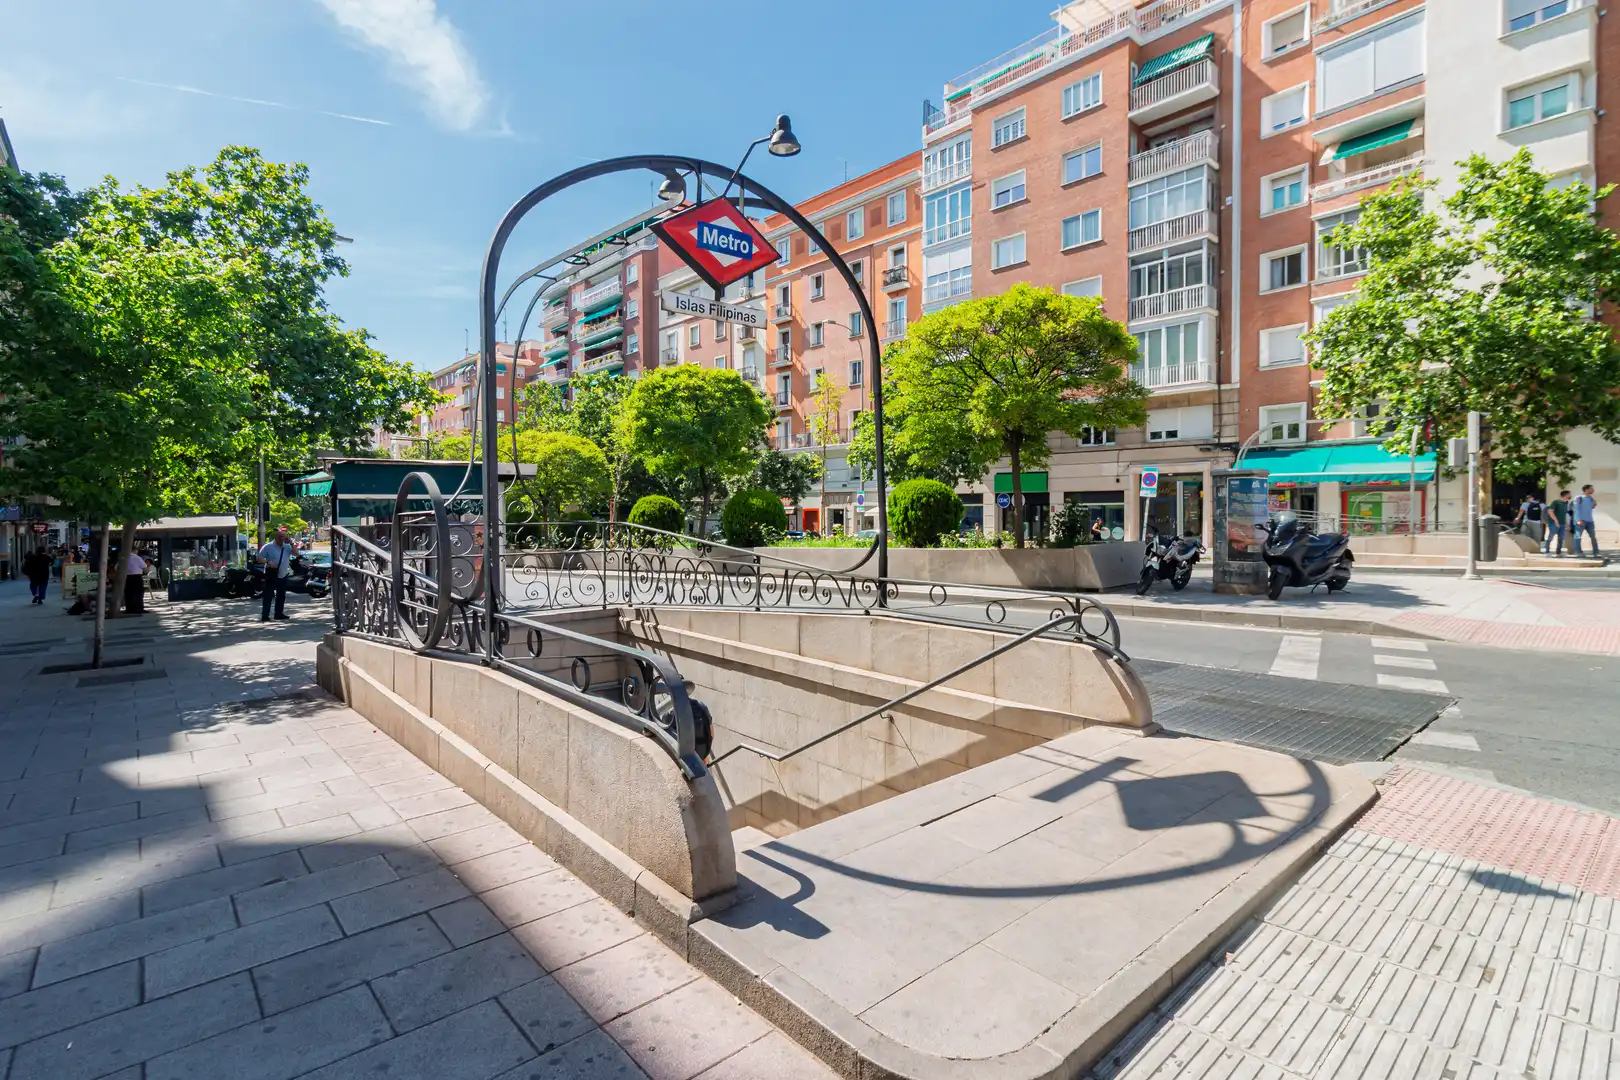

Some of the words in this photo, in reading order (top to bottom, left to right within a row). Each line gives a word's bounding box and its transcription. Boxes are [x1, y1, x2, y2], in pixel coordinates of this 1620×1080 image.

[703, 226, 749, 254] Metro
[676, 296, 705, 313] Islas
[709, 303, 757, 324] Filipinas
